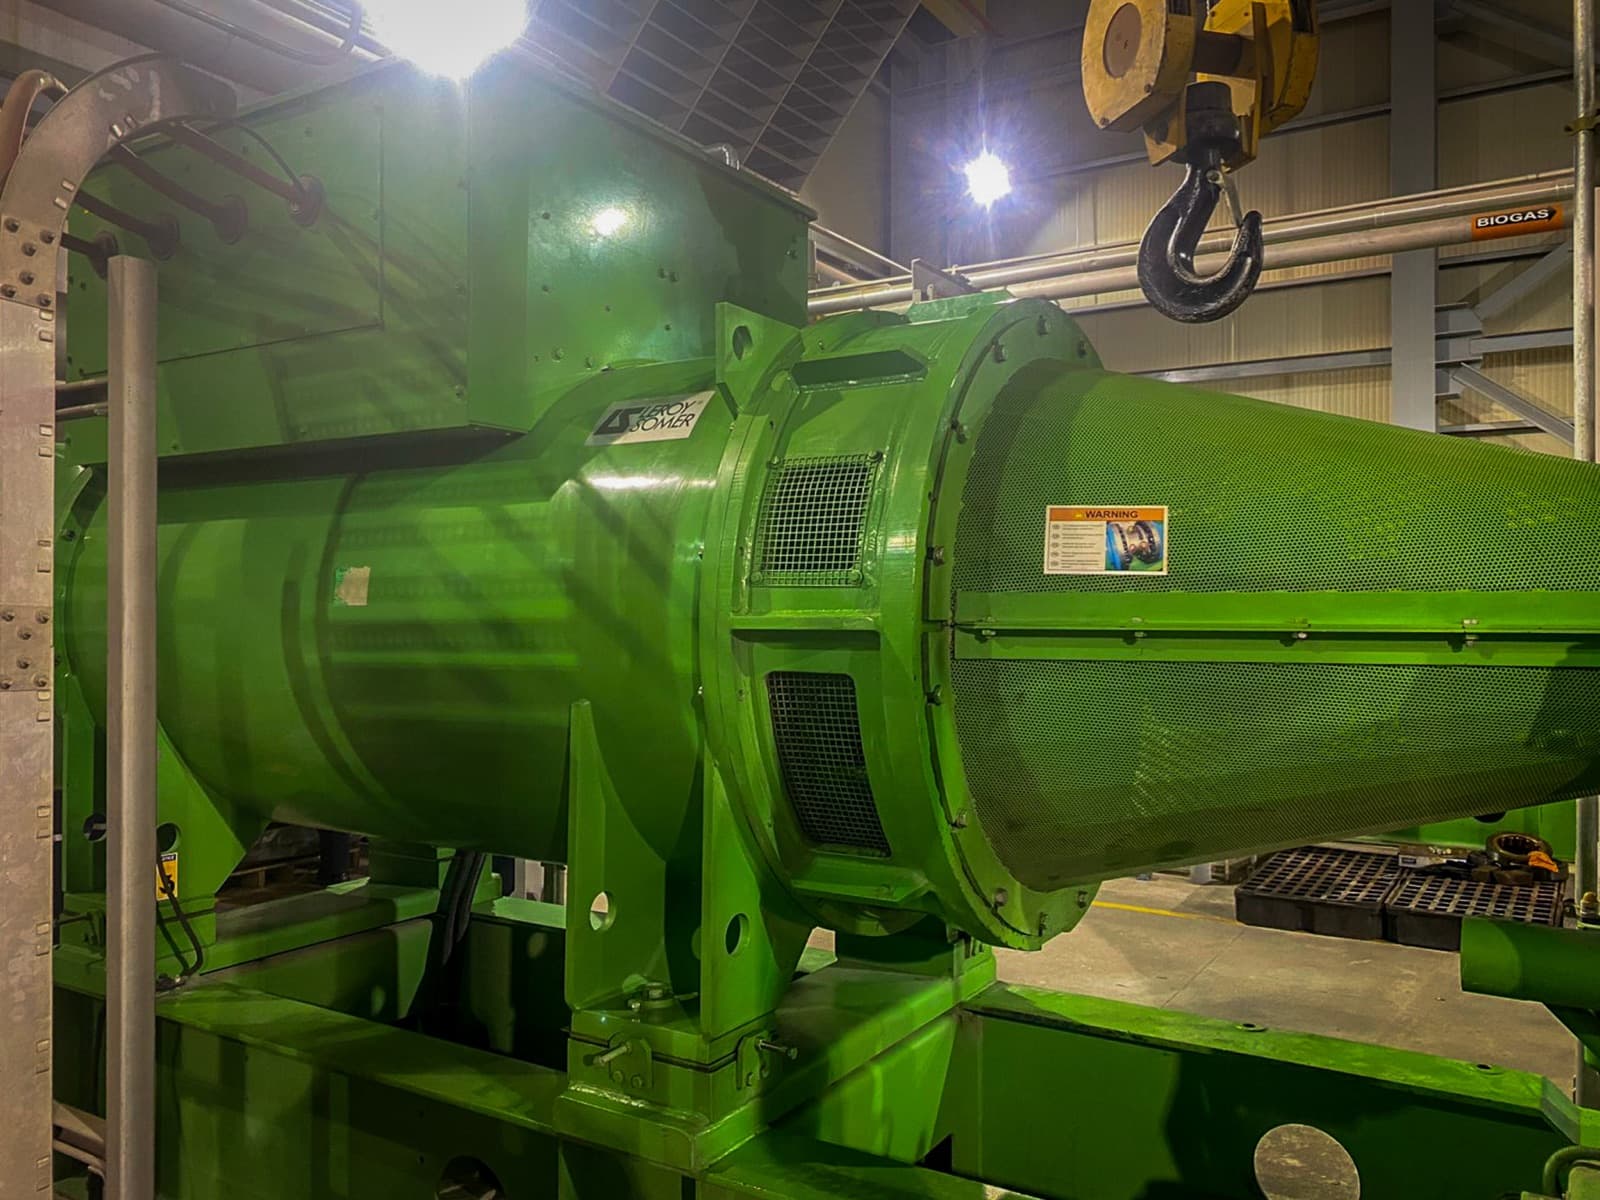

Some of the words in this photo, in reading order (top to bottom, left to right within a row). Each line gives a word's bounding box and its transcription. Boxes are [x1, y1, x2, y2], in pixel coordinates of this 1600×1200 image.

[1477, 209, 1549, 227] BIOGAS
[638, 401, 697, 418] LEROY
[629, 413, 695, 432] SOMER
[1085, 510, 1138, 519] WARNING
